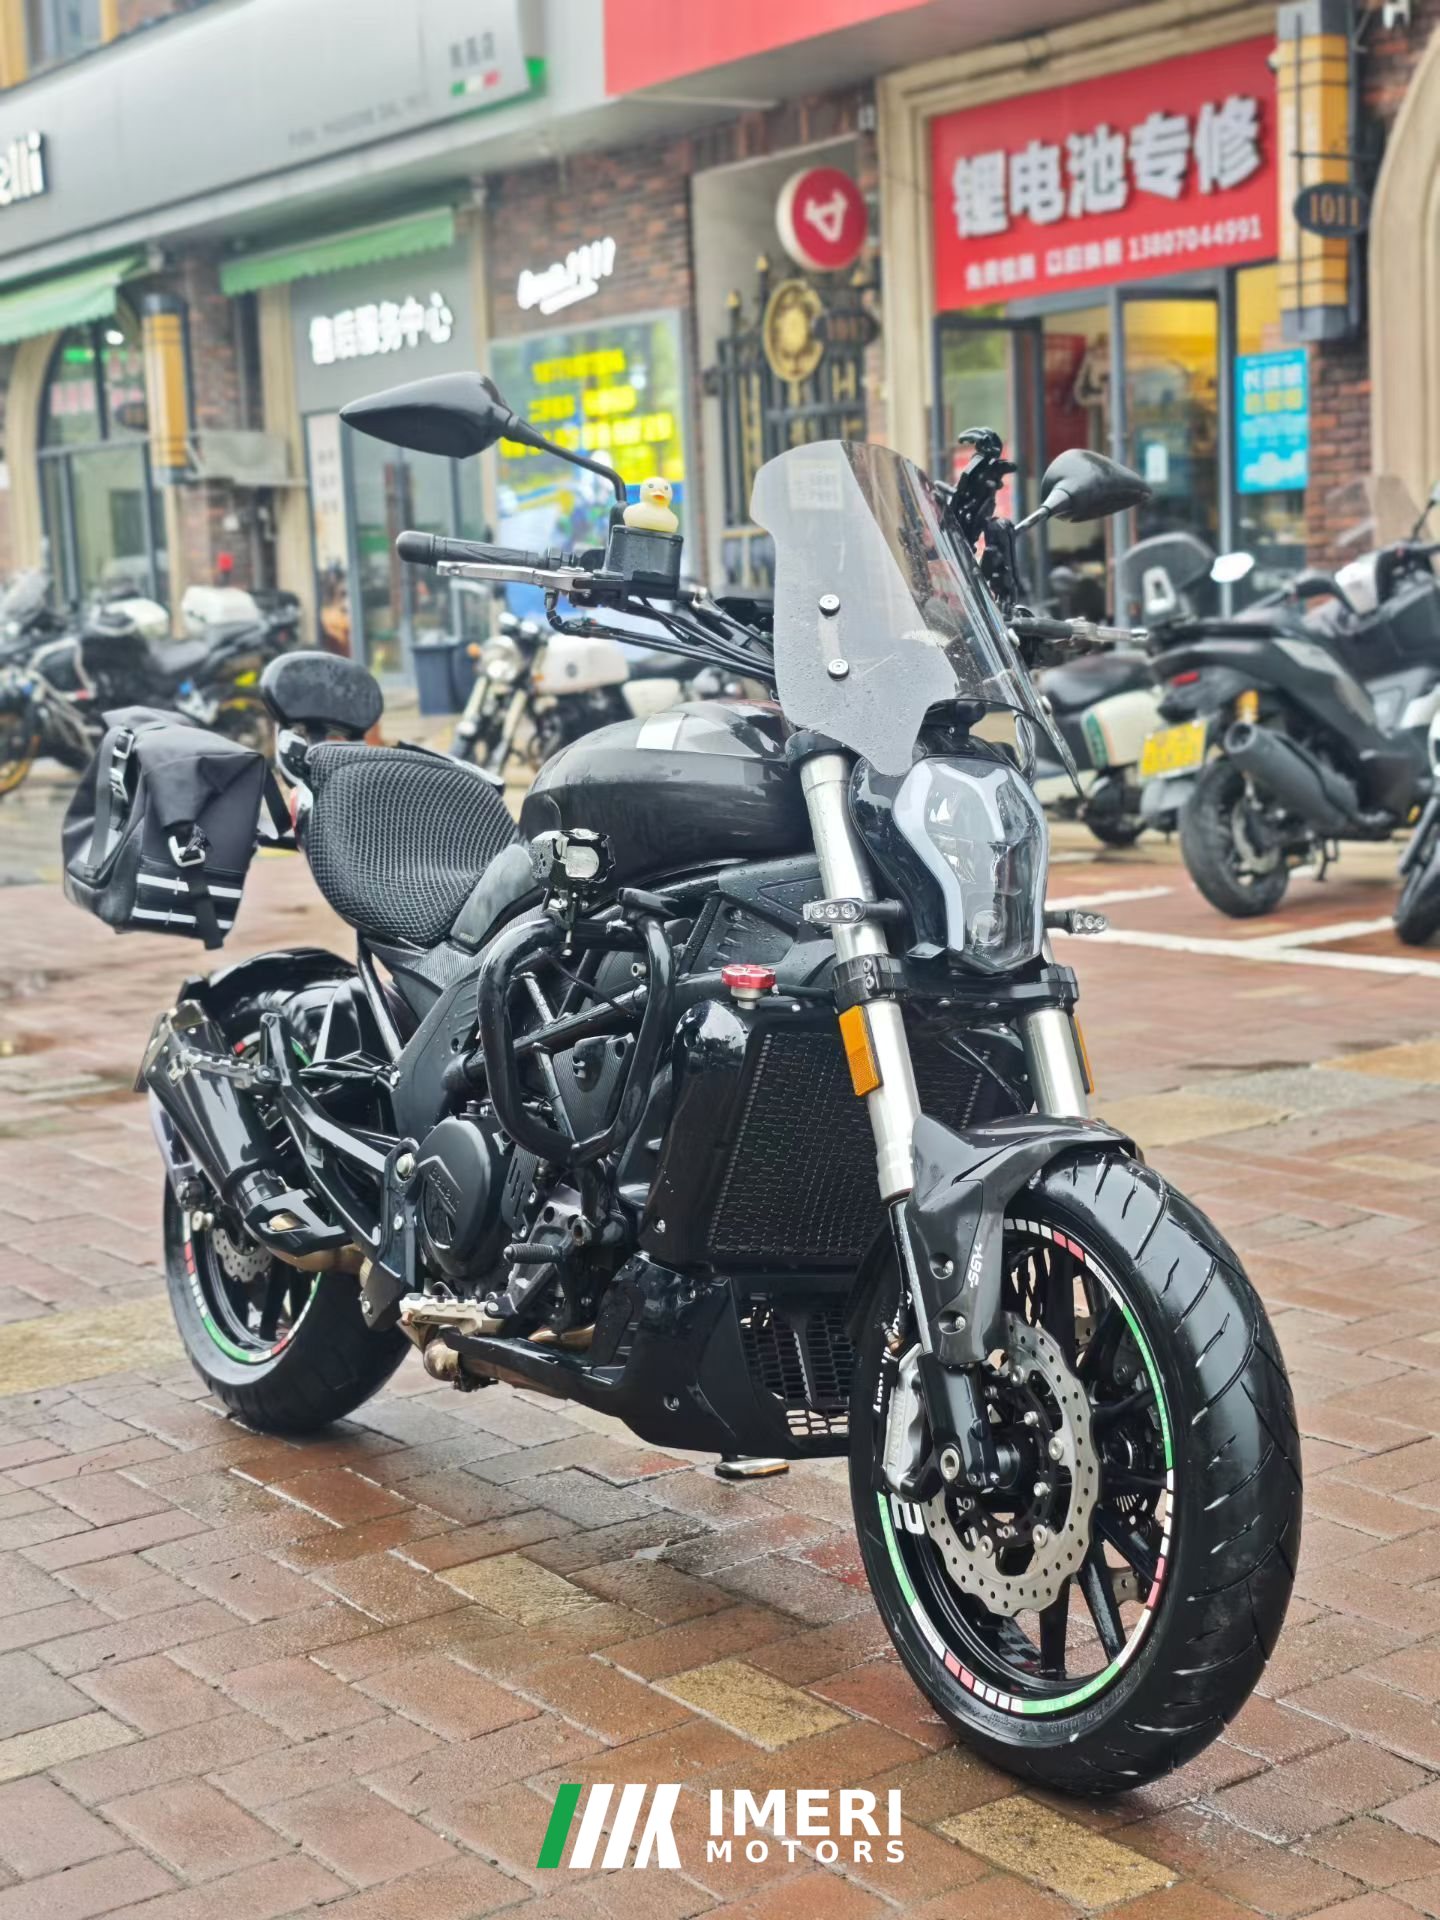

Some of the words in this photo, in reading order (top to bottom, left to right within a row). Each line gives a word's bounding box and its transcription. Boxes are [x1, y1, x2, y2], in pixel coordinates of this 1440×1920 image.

[953, 94, 1262, 240] 锂电池专修
